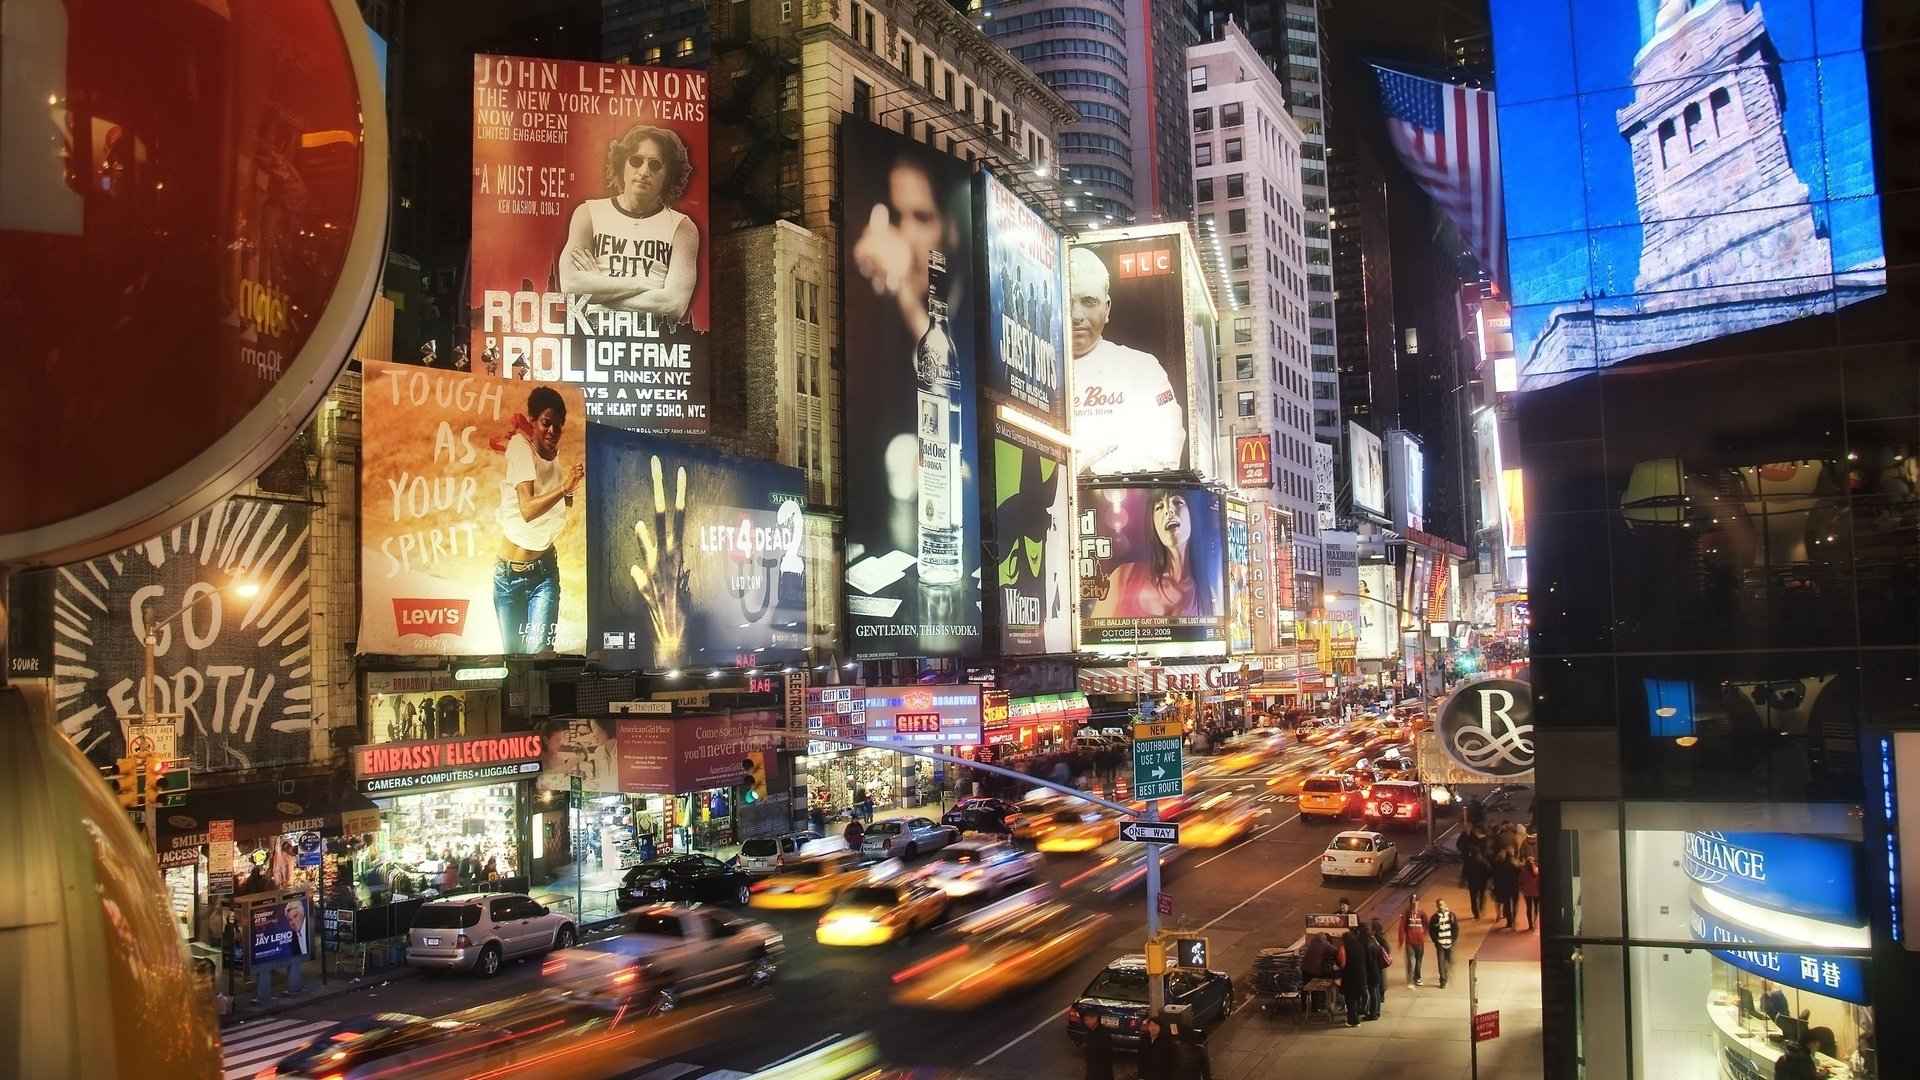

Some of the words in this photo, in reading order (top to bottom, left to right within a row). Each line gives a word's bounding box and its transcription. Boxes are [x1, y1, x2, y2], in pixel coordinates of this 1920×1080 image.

[478, 58, 558, 90] JOHN
[478, 87, 508, 108] THE
[516, 91, 550, 111] NEW
[559, 92, 600, 115] YORK
[609, 97, 643, 118] CITY
[652, 100, 704, 122] YEARS
[477, 109, 514, 127] NOW
[523, 112, 568, 130] OPEN
[477, 127, 509, 141] LIMITED
[513, 128, 568, 144] ENGAGEMENT
[497, 164, 533, 196] MUST
[498, 199, 511, 214] KEN
[592, 233, 627, 259] NEW
[633, 240, 673, 268] YORK
[609, 255, 654, 277] CITY
[1122, 254, 1169, 273] TLC
[483, 290, 595, 336] ROCK
[598, 311, 660, 338] HALL
[1000, 312, 1033, 378] JERSEY
[502, 336, 609, 382] ROLL
[598, 341, 627, 366] OF
[630, 344, 692, 368] FAME
[1034, 334, 1057, 391] BOYS
[614, 370, 662, 384] ANNEX
[664, 372, 692, 386] NYC
[382, 369, 503, 421] TOUGH
[616, 389, 627, 399] A
[635, 389, 688, 401] WEEK
[1010, 373, 1026, 392] BEST
[1026, 382, 1050, 403] MUSICAL
[1084, 386, 1125, 408] Boss
[586, 403, 603, 416] THE
[606, 404, 637, 417] HEART
[640, 405, 652, 416] OF
[656, 405, 685, 419] SOHO,
[687, 405, 706, 418] NYC
[434, 421, 478, 465] AS
[1246, 469, 1263, 478] 24
[388, 472, 478, 522] YOUR
[701, 525, 736, 553] LEFT
[736, 518, 753, 558] 4
[755, 526, 795, 552] DEAD
[777, 499, 804, 574] 2
[1228, 522, 1248, 544] SOUTH
[381, 523, 485, 579] SPIRIT.
[1326, 551, 1356, 560] MAXIMUM
[1251, 512, 1267, 619] PALACE
[1327, 560, 1357, 568] PERFORMANCE
[1327, 567, 1341, 576] LIVES
[1081, 585, 1108, 599] City
[130, 582, 222, 656] GO
[1107, 618, 1131, 626] BALLAD
[1132, 618, 1140, 626] OF
[1141, 617, 1153, 625] GAY
[1154, 617, 1168, 625] TONY
[1328, 608, 1357, 620] maxell
[856, 625, 919, 638] GENTLEMEN,
[920, 625, 940, 636] THIS
[941, 625, 949, 636] IS
[950, 625, 980, 636] VODKA.
[1102, 628, 1141, 637] OCTOBER
[1142, 628, 1154, 638] 29,
[1155, 628, 1171, 636] 2009
[12, 658, 39, 671] SQUARE
[393, 677, 429, 690] BROADWAY
[1145, 668, 1200, 692] TREE
[824, 690, 835, 701] GIFT
[839, 689, 849, 699] NYC
[932, 695, 977, 706] BROADWAY
[106, 665, 276, 744] FORTH
[838, 702, 850, 712] GIFT
[852, 701, 863, 711] NYC
[810, 717, 820, 728] NYC
[852, 713, 864, 723] GIFT
[897, 715, 938, 731] GIFTS
[1477, 690, 1535, 754] R
[656, 725, 671, 733] Place
[696, 727, 718, 739] Come
[720, 723, 742, 738] spend
[1150, 726, 1166, 735] NEW
[684, 744, 706, 762] you'll
[707, 742, 737, 757] never
[810, 743, 821, 753] NYC
[825, 741, 836, 751] GIFT
[1136, 739, 1179, 752] SOUTHBOUND
[364, 745, 441, 774] EMBASSY
[447, 735, 542, 766] ELECTRONICS
[1140, 755, 1154, 766] USE
[1156, 753, 1161, 764] 7
[1163, 752, 1176, 762] AVE
[367, 777, 413, 791] CAMERAS
[420, 769, 474, 785] COMPUTERS
[480, 765, 518, 778] LUGGAGE
[1139, 784, 1156, 797] BEST
[1158, 780, 1179, 793] ROUTE
[167, 797, 172, 805] 7
[282, 817, 325, 833] SMILER'S
[1129, 827, 1146, 836] ONE
[1153, 829, 1172, 838] WAY
[163, 847, 200, 863] ACCESS
[1685, 834, 1766, 881] EXCHANGE
[255, 935, 269, 946] JAY
[271, 931, 292, 943] LENO
[1800, 955, 1841, 988] 両替
